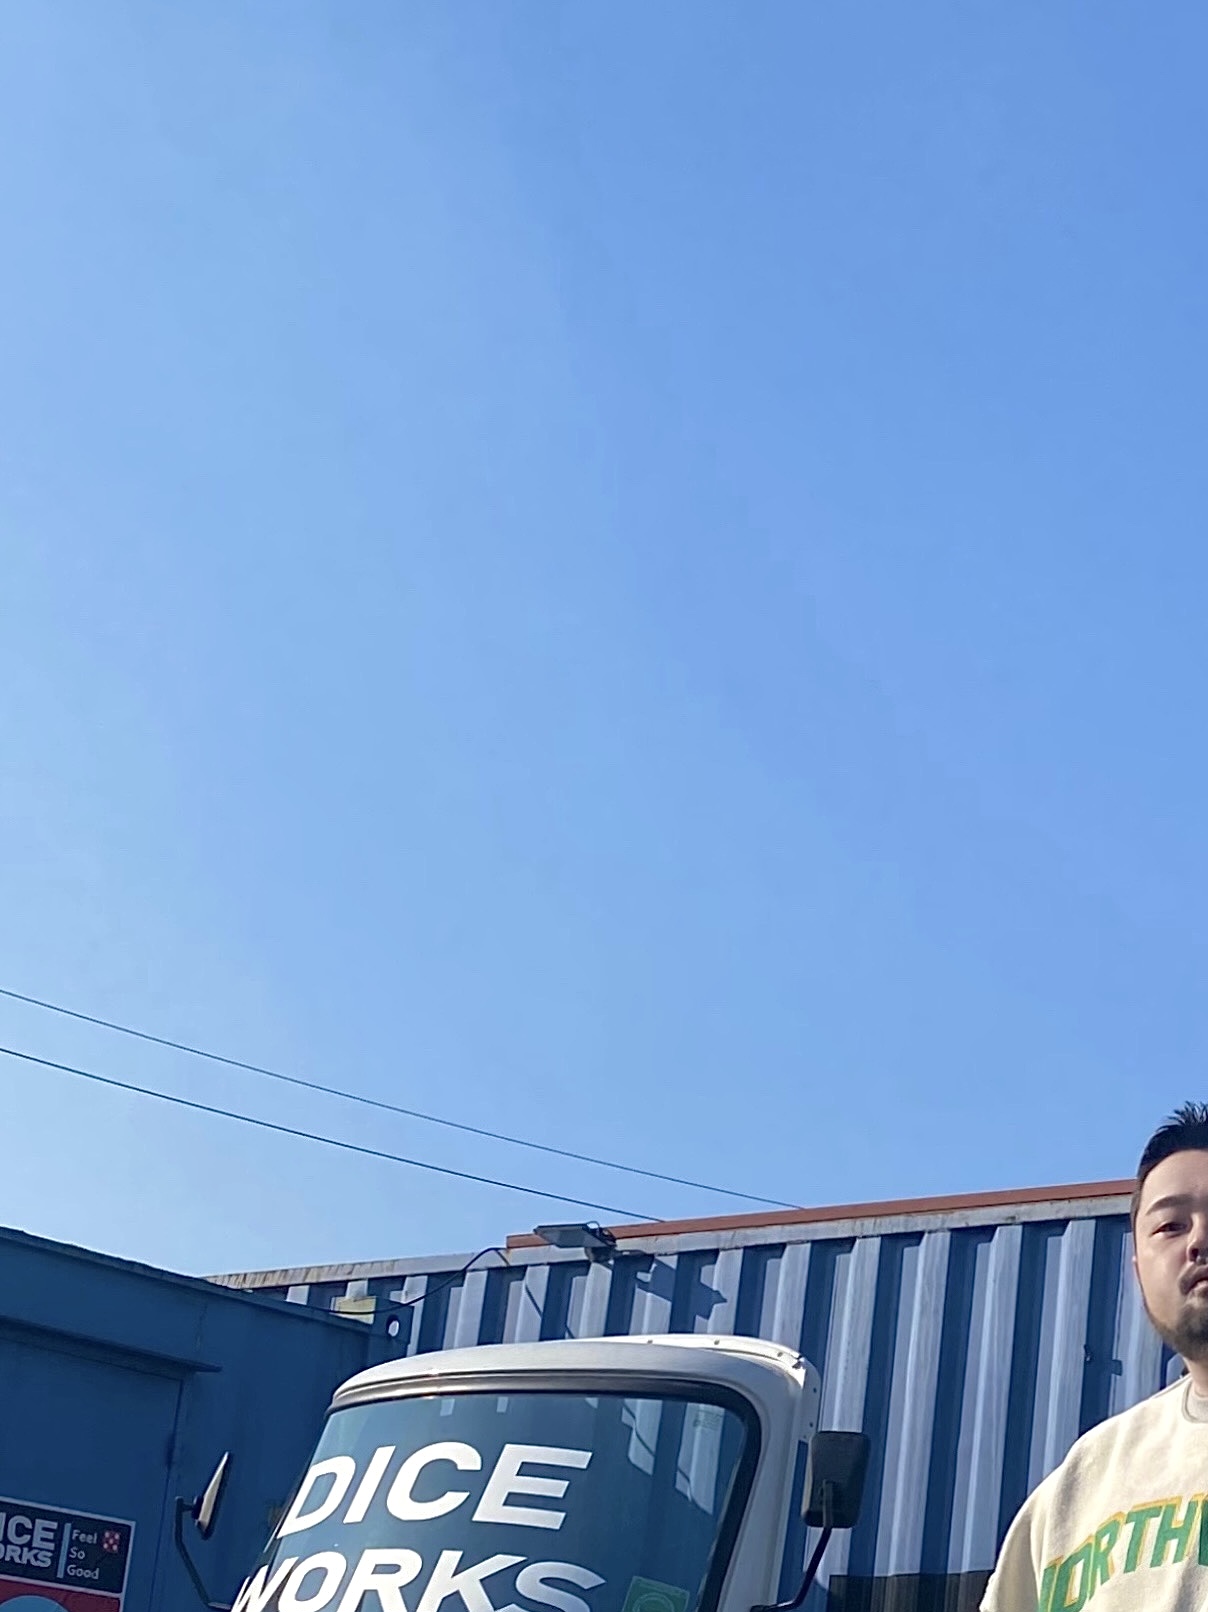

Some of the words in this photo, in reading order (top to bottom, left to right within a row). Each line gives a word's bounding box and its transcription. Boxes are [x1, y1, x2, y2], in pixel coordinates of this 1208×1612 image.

[277, 1442, 592, 1540] DICE
[72, 1529, 98, 1544] Feel
[69, 1546, 86, 1560] So
[66, 1564, 100, 1580] Good
